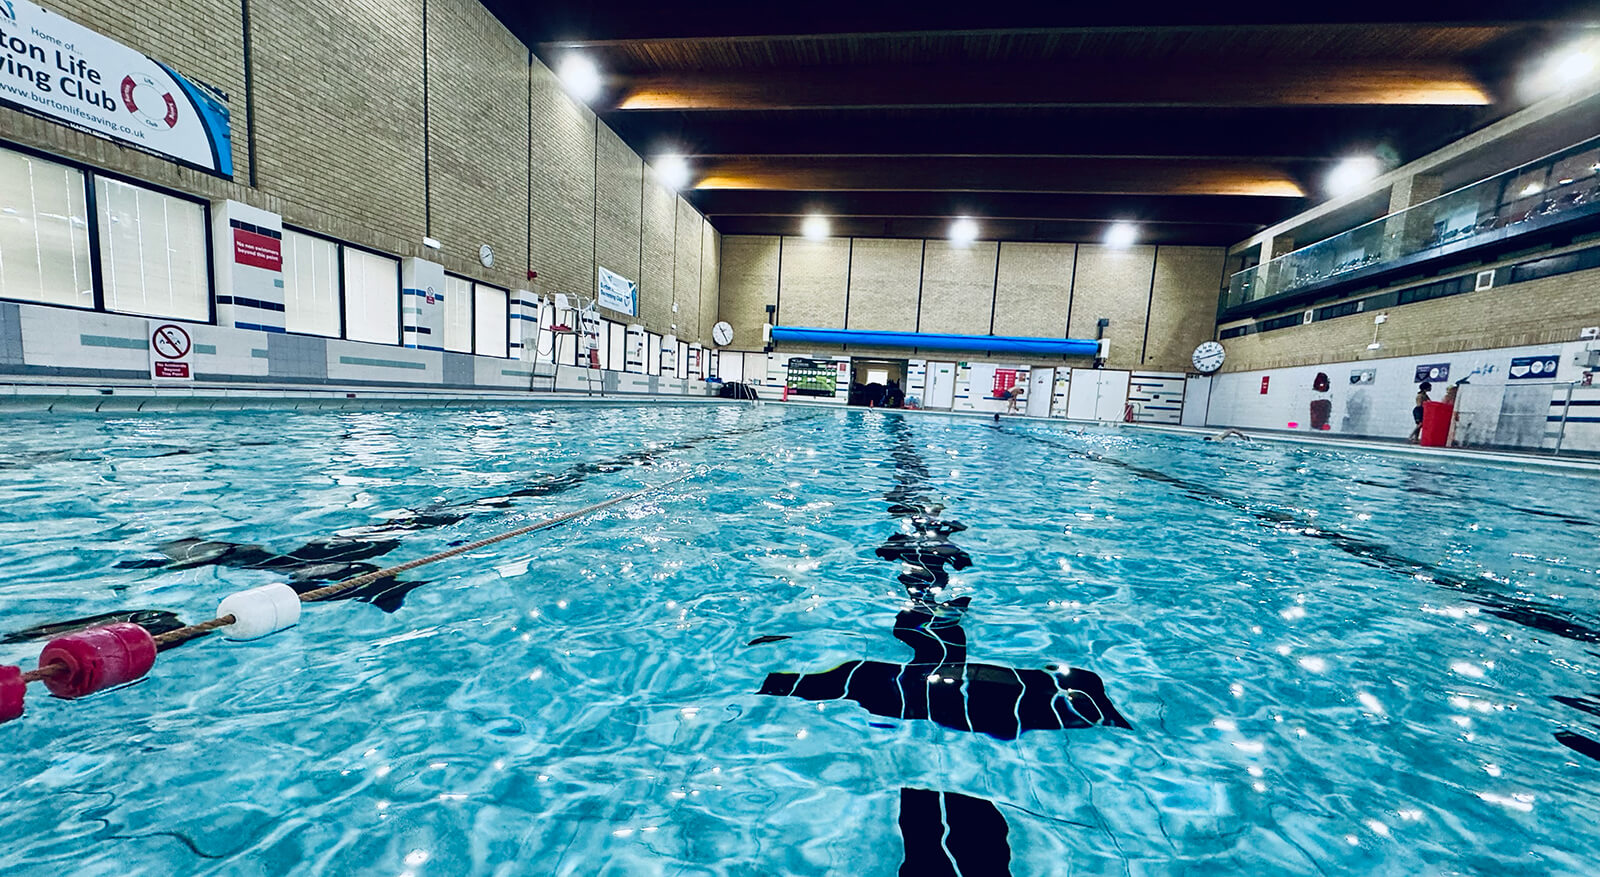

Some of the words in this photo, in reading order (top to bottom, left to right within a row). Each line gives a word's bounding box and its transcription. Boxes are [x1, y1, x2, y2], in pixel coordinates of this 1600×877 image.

[31, 26, 62, 46] Home
[55, 50, 102, 86] Life
[59, 76, 117, 112] Club
[238, 247, 256, 256] beyond
[255, 246, 279, 255] swimmers
